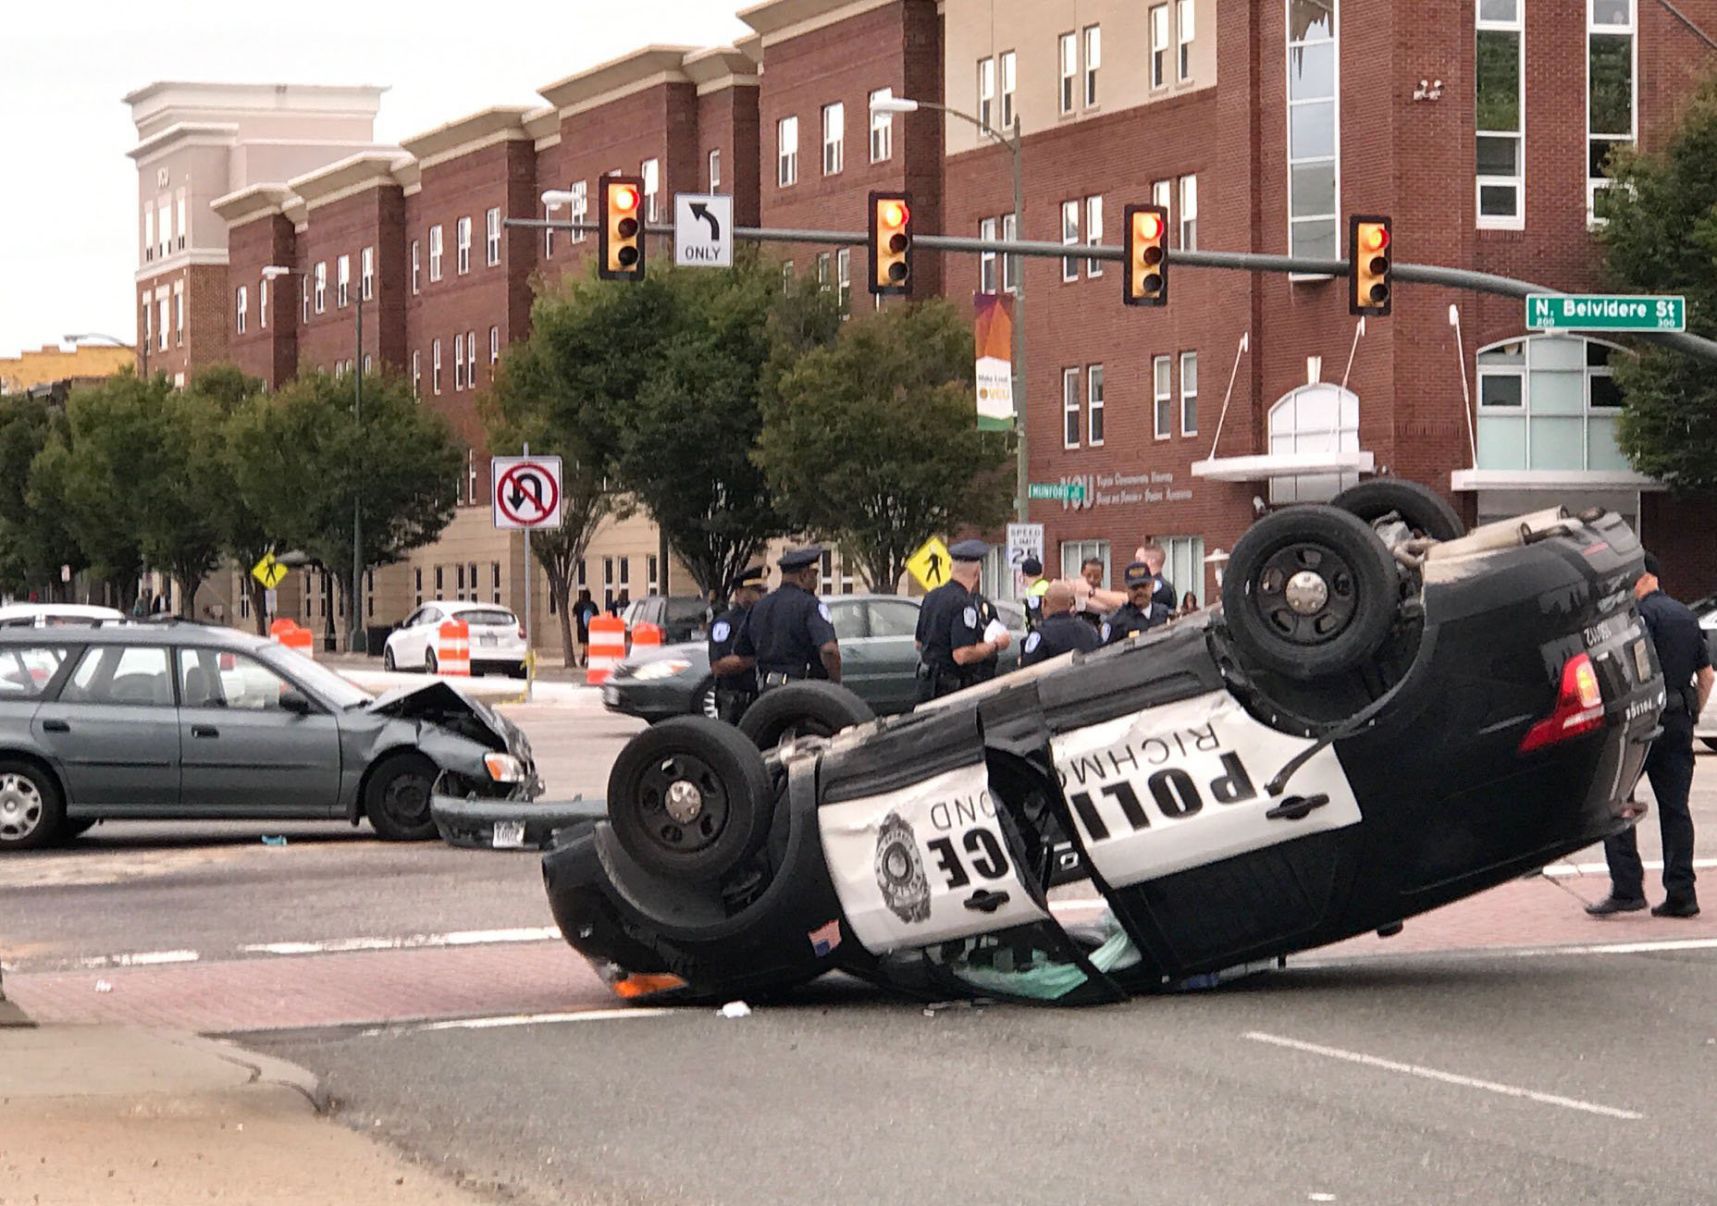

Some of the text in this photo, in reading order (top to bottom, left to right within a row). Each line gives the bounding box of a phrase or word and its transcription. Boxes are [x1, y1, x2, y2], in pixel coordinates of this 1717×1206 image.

[685, 245, 721, 261] ONLY
[1536, 299, 1675, 318] N. Belvidere St
[1010, 528, 1041, 537] SPEED
[1013, 537, 1037, 545] LIMIT
